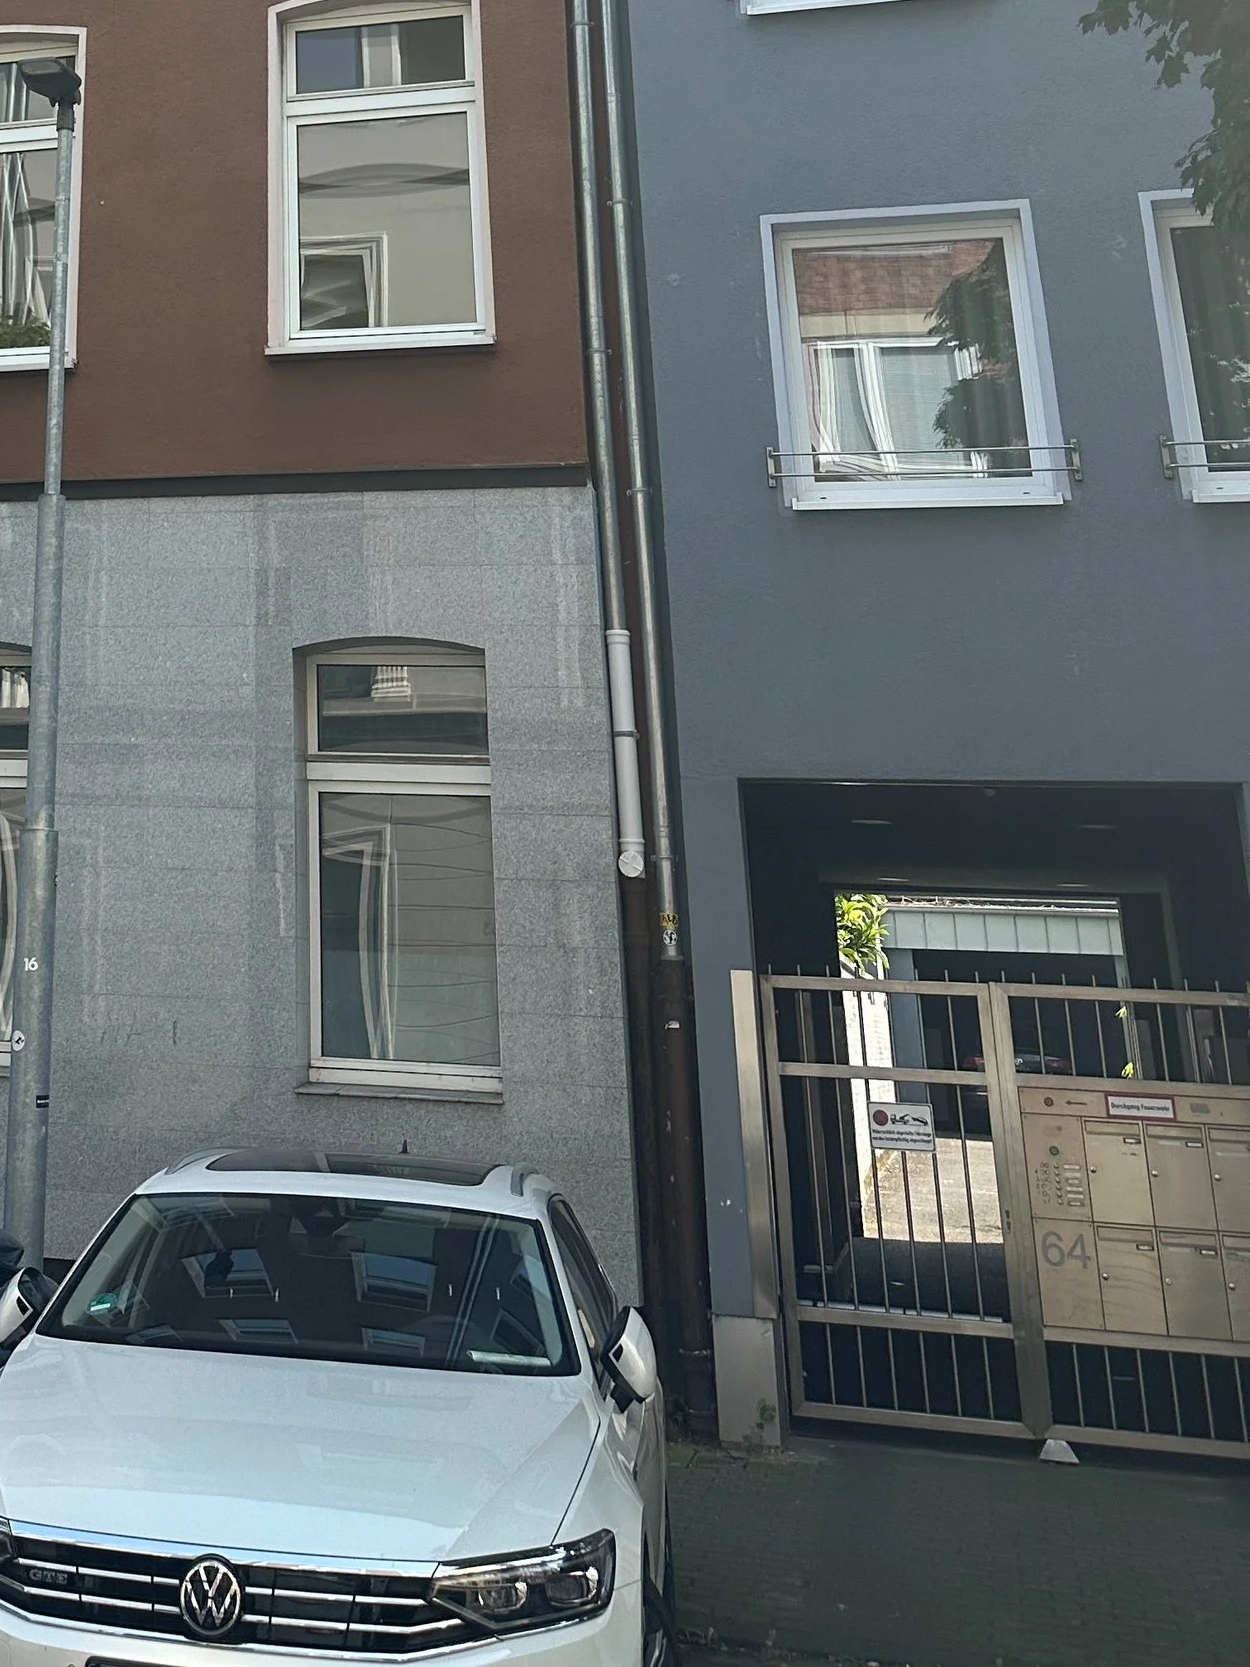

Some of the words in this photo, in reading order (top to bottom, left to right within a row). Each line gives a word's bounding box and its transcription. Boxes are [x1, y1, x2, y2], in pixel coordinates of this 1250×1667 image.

[23, 957, 39, 972] 16
[1041, 1230, 1091, 1270] 64
[28, 1568, 69, 1585] GTE
